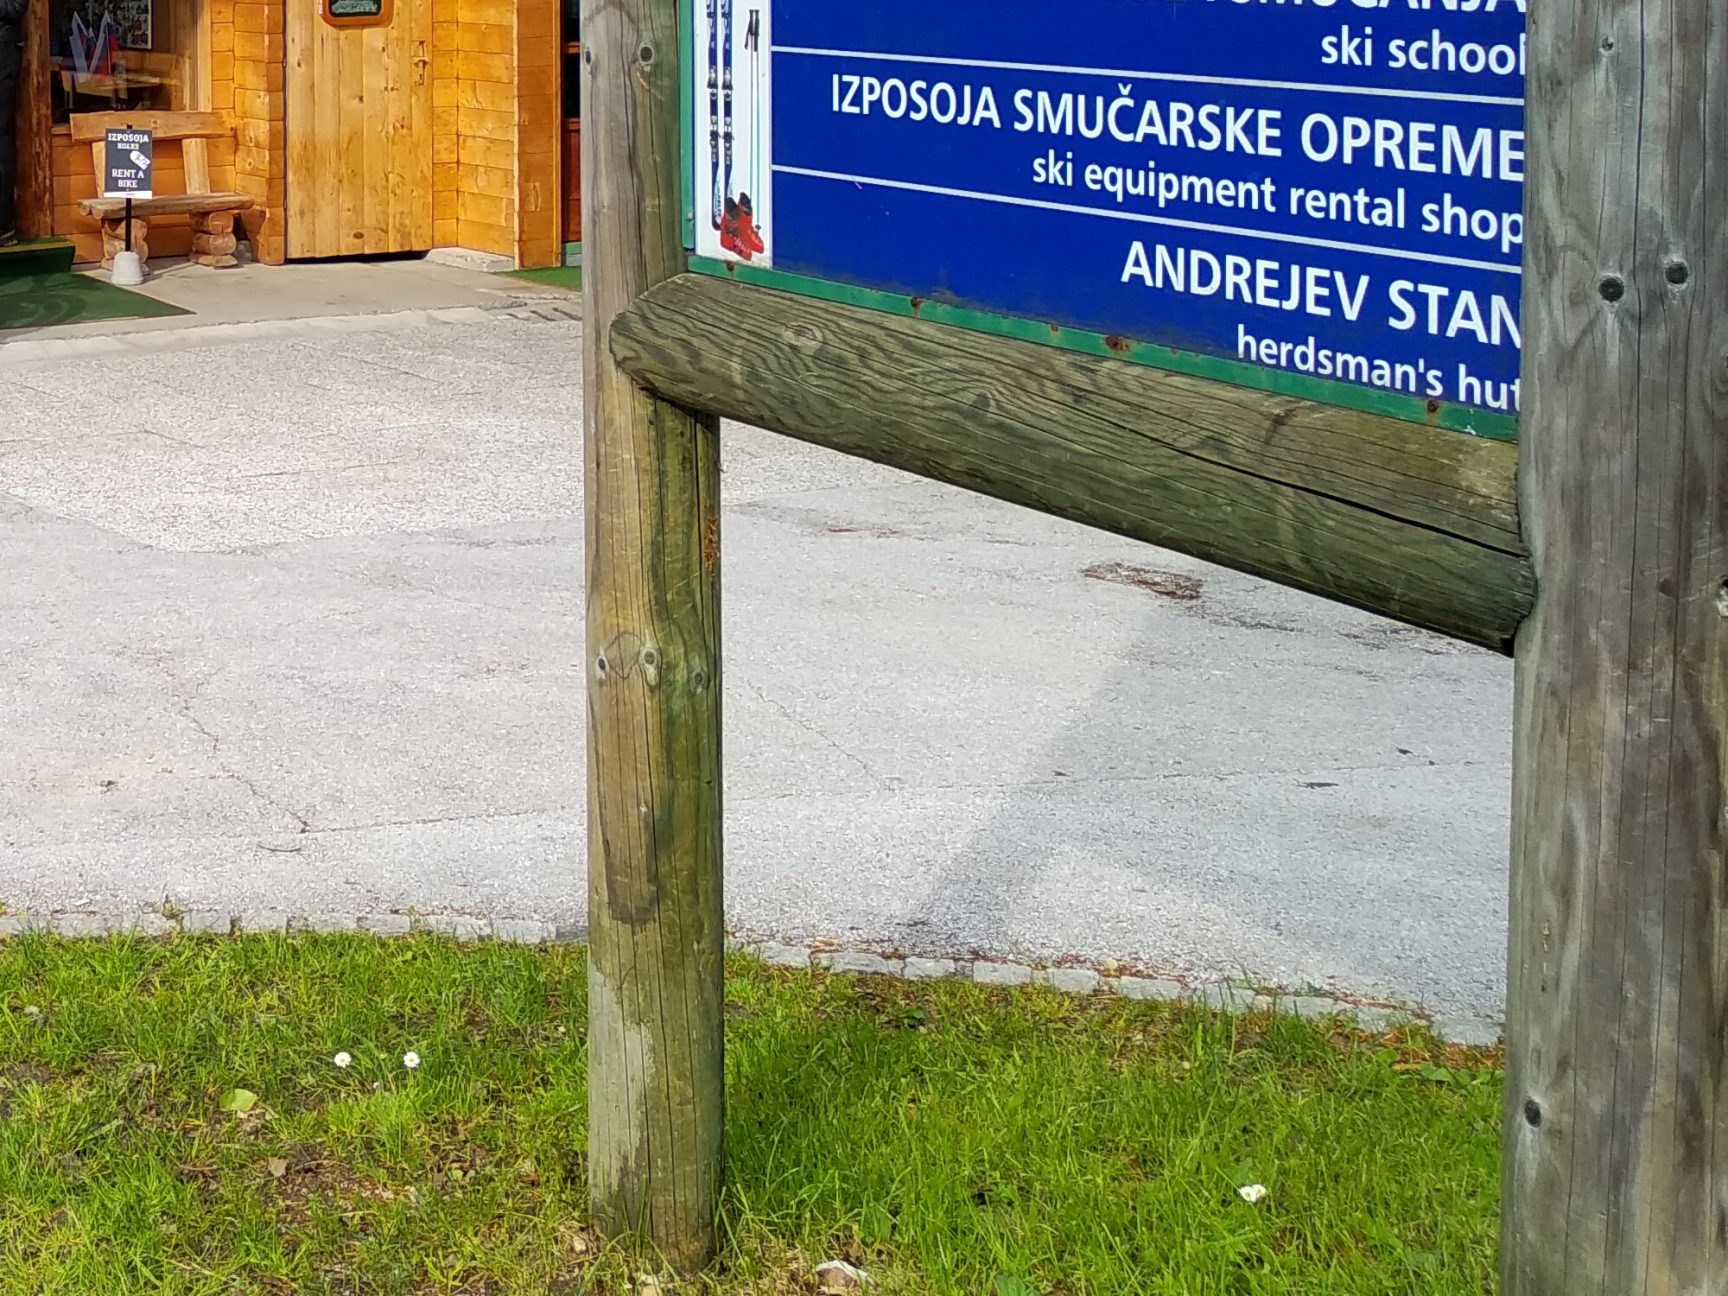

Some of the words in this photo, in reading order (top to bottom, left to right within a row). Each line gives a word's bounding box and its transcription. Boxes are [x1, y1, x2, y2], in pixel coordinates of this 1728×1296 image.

[1321, 25, 1372, 66] ski
[1388, 29, 1525, 75] school
[108, 133, 149, 143] IZPOSOJA
[831, 72, 1001, 129] IZPOSOJA
[1013, 83, 1282, 157] SMUČARSKE
[1301, 112, 1524, 182] OPREME
[112, 169, 136, 178] RENT
[137, 170, 144, 178] A
[118, 180, 138, 188] BIKE
[1032, 147, 1074, 188] ski
[1084, 160, 1275, 213] equipment
[1290, 187, 1405, 228] rental
[1422, 192, 1523, 253] shop
[1120, 241, 1370, 322] ANDREJEV
[1388, 279, 1521, 349] STAN
[1237, 323, 1443, 397] herdsman's
